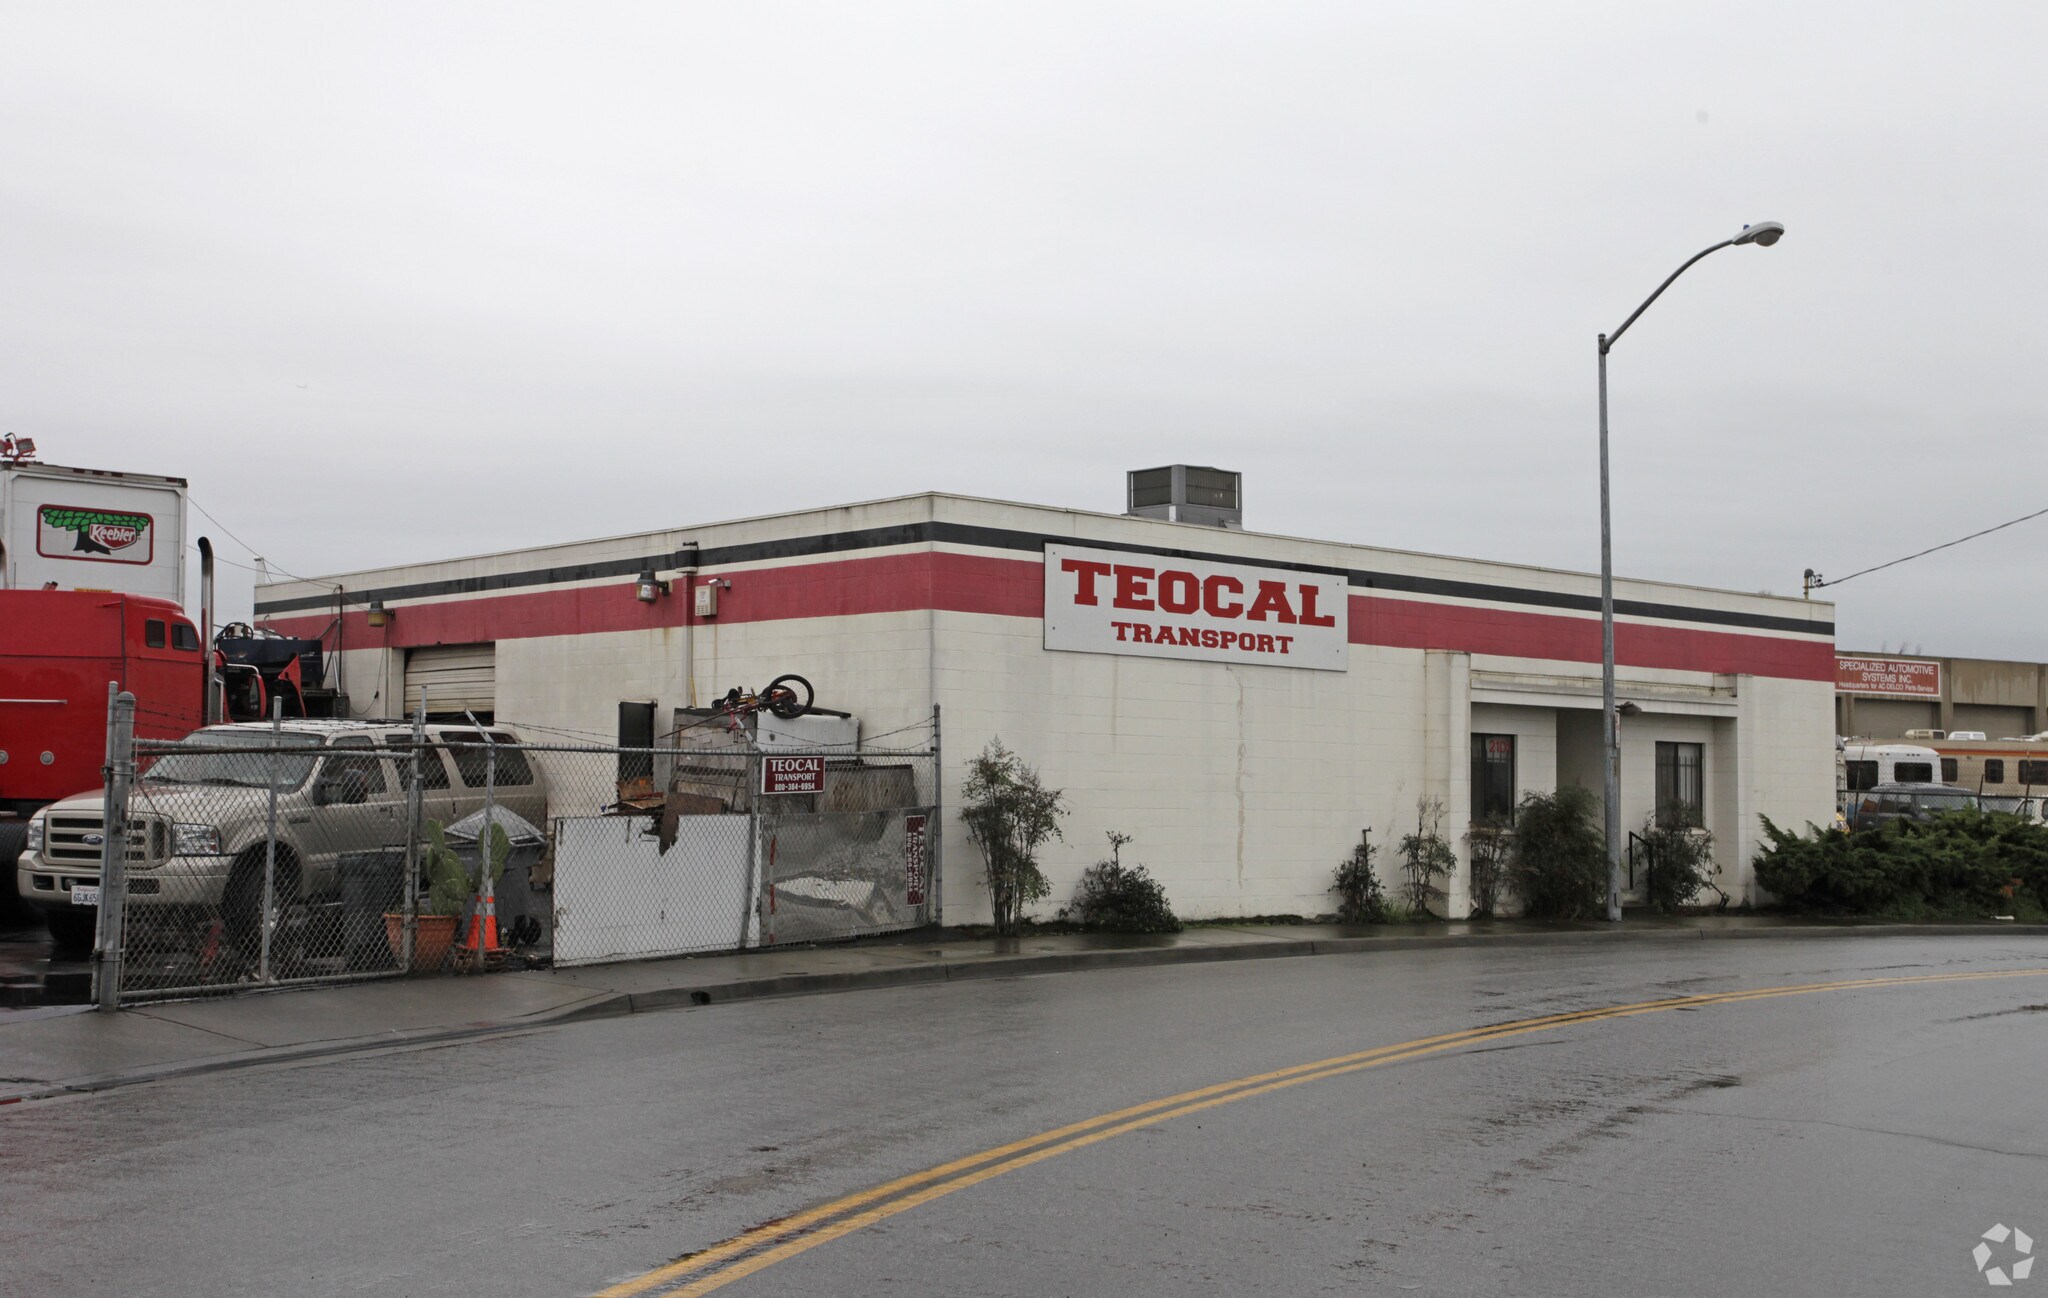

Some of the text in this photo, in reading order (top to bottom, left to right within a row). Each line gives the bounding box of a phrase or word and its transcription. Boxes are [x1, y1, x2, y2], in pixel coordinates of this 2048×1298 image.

[91, 525, 135, 542] Keebler
[1061, 558, 1335, 627] TEOCAL
[1111, 621, 1294, 654] TRANSPORT
[1839, 660, 1934, 675] SPECIALIZED AUTOMOTIVE
[1862, 672, 1912, 684] SYSTEMS INC.
[770, 759, 820, 771] TEOCAL
[774, 773, 816, 781] TRANSPORT
